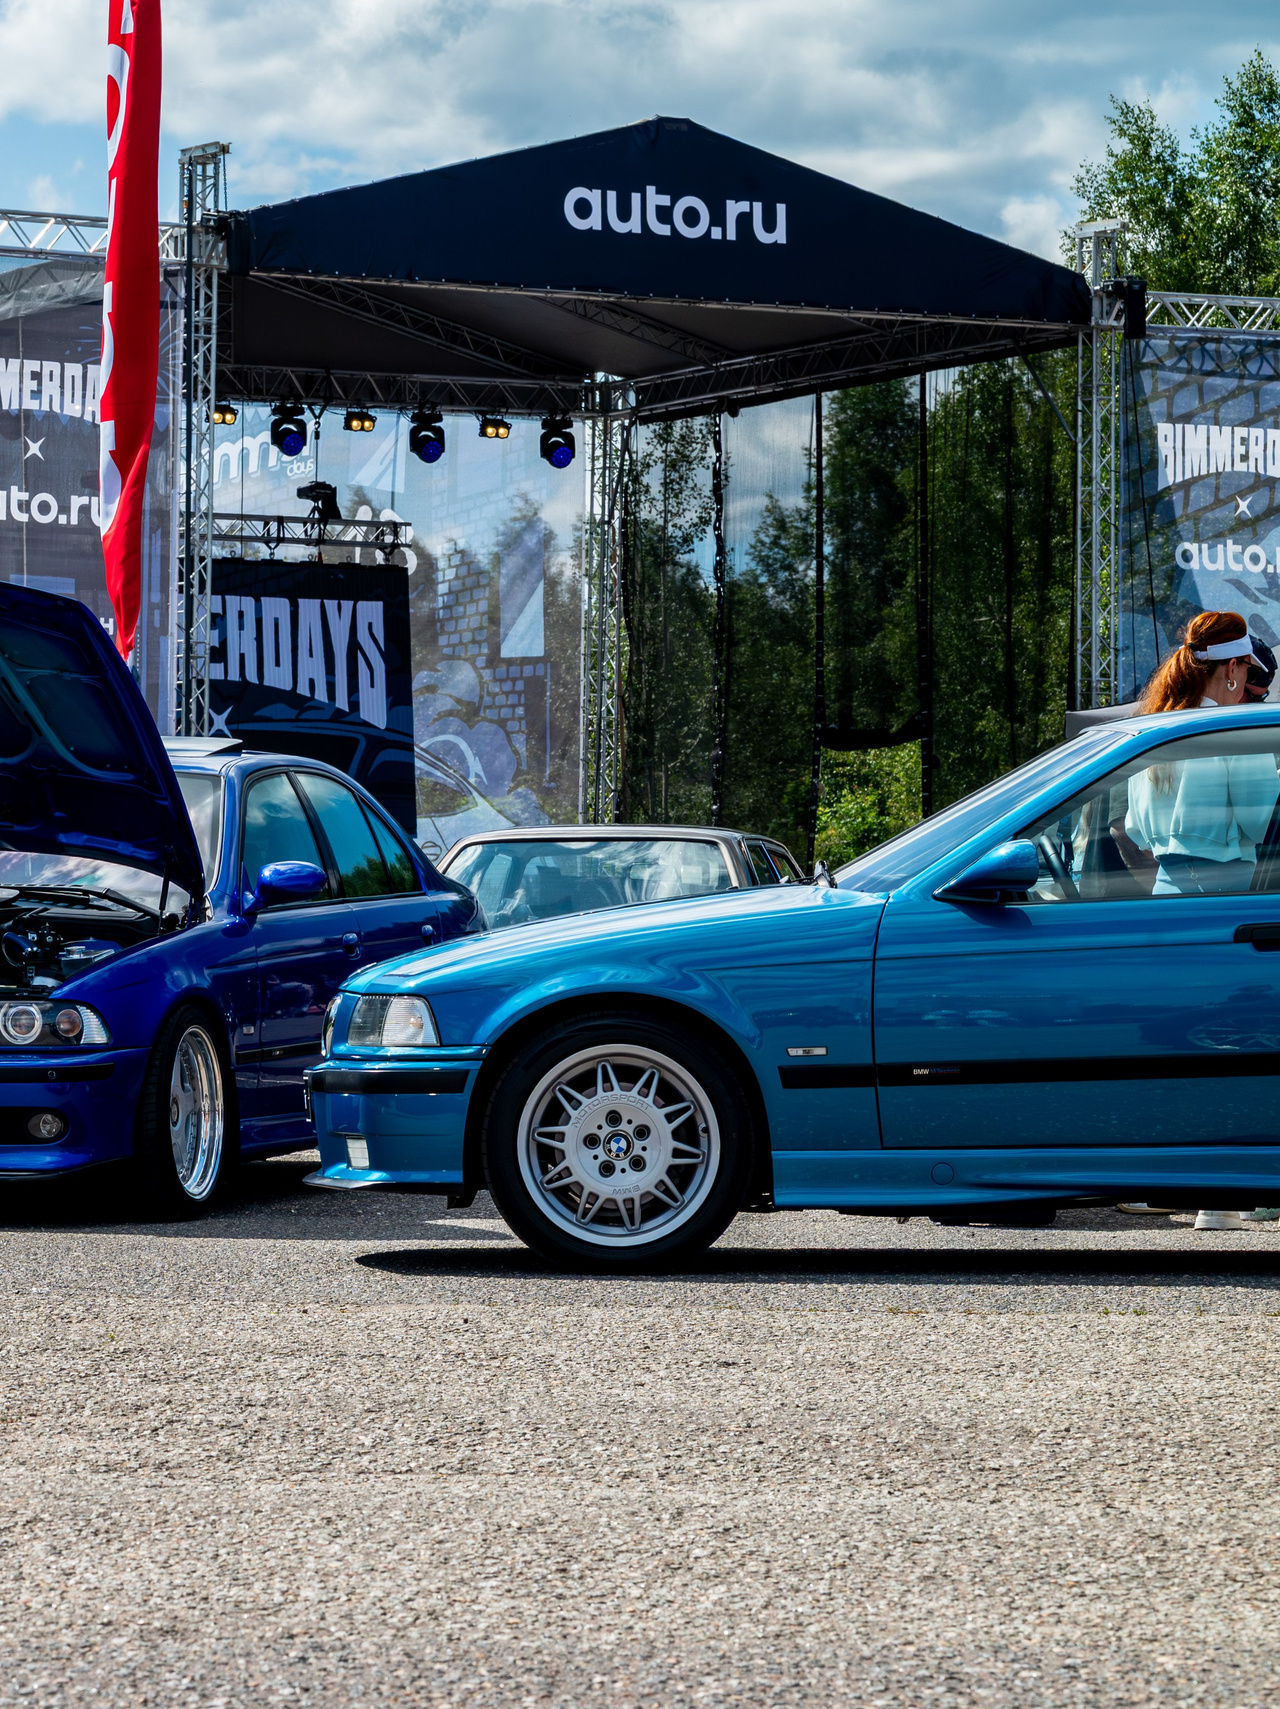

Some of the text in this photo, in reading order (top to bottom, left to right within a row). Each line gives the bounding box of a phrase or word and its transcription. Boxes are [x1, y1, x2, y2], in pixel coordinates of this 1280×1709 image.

[563, 185, 787, 244] auto.ru
[1174, 539, 1280, 574] auto.
[572, 1094, 653, 1128] MOTORSPORT
[611, 1184, 641, 1197] BMW
